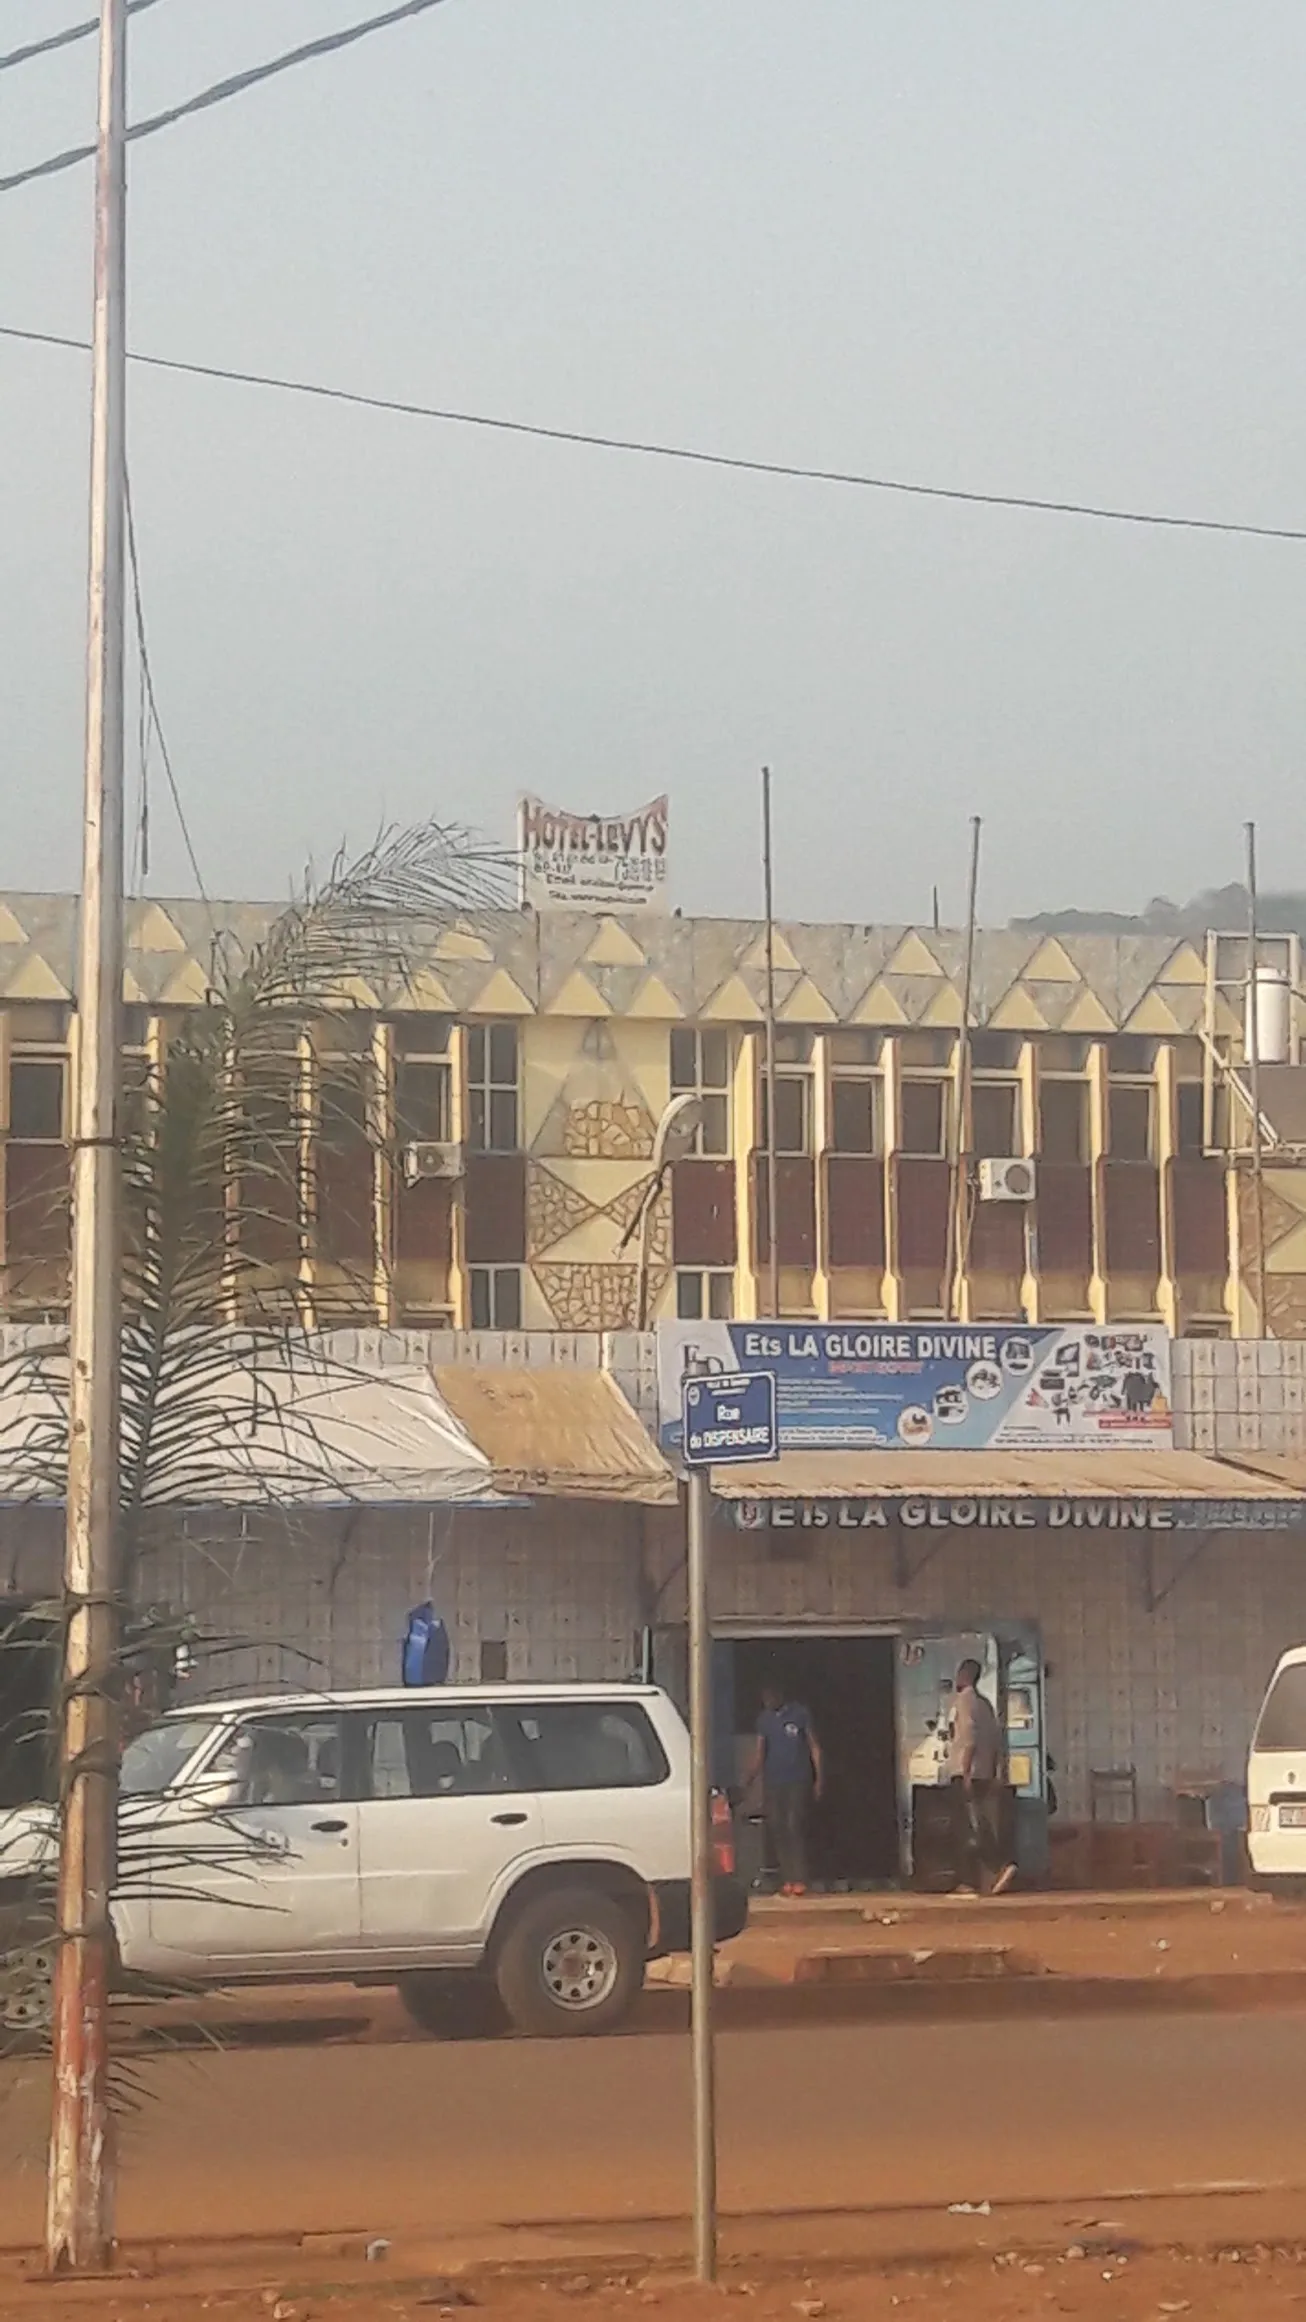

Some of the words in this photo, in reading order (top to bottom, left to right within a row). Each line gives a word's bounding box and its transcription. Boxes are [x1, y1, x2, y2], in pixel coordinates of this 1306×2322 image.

[744, 1333, 782, 1357] Ets
[788, 1334, 819, 1358] LA
[825, 1334, 911, 1358] GLOIRE
[917, 1335, 996, 1359] DIVINE
[703, 1426, 769, 1447] DISPENSAIRE
[838, 1500, 888, 1527] LA
[900, 1498, 1036, 1527] GLOIRE
[1048, 1499, 1173, 1528] DIVINE
